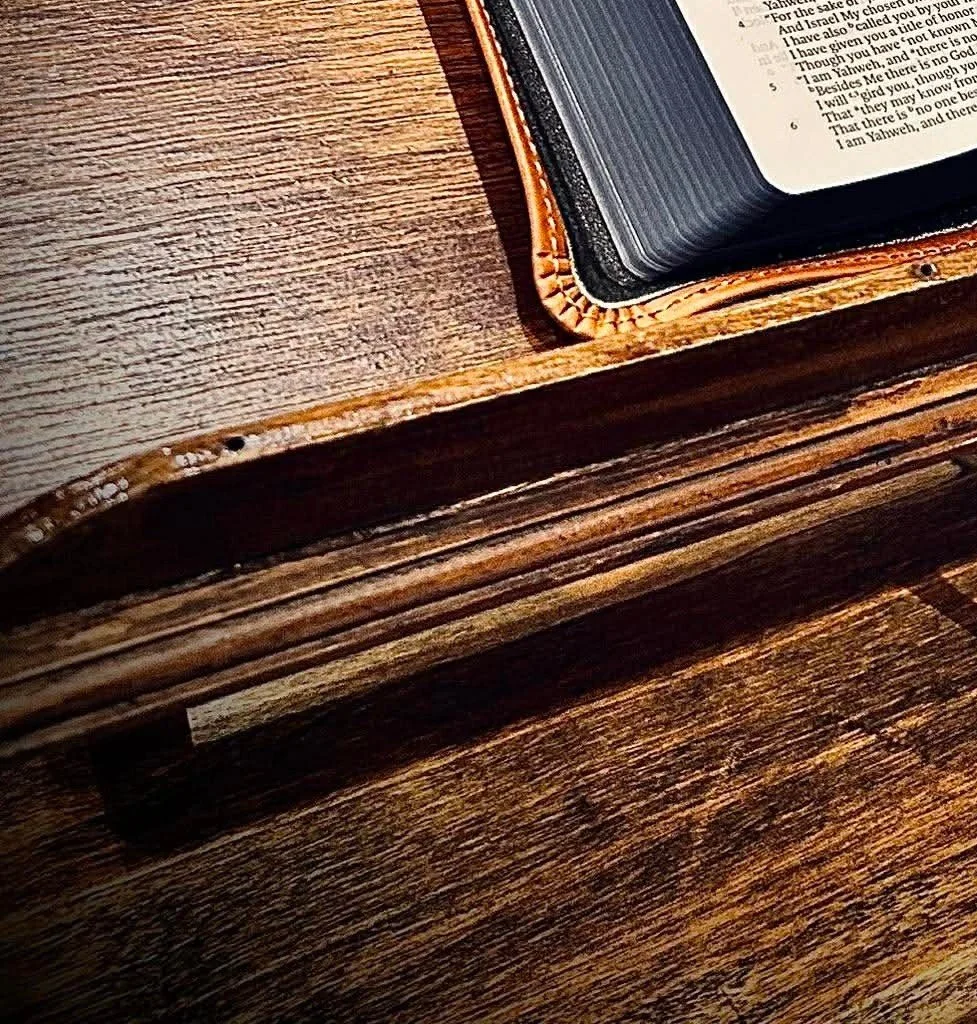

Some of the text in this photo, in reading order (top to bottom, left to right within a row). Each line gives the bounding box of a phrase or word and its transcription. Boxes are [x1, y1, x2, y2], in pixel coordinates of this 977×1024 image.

[778, 20, 805, 35] And
[803, 13, 840, 29] Israel
[862, 0, 906, 16] chosen
[795, 45, 828, 58] have
[828, 37, 864, 54] given
[863, 31, 888, 45] you
[897, 20, 924, 34] title
[937, 6, 975, 23] honor
[821, 109, 854, 123] That
[889, 93, 916, 108] may
[916, 82, 952, 100] know
[919, 112, 946, 129] and
